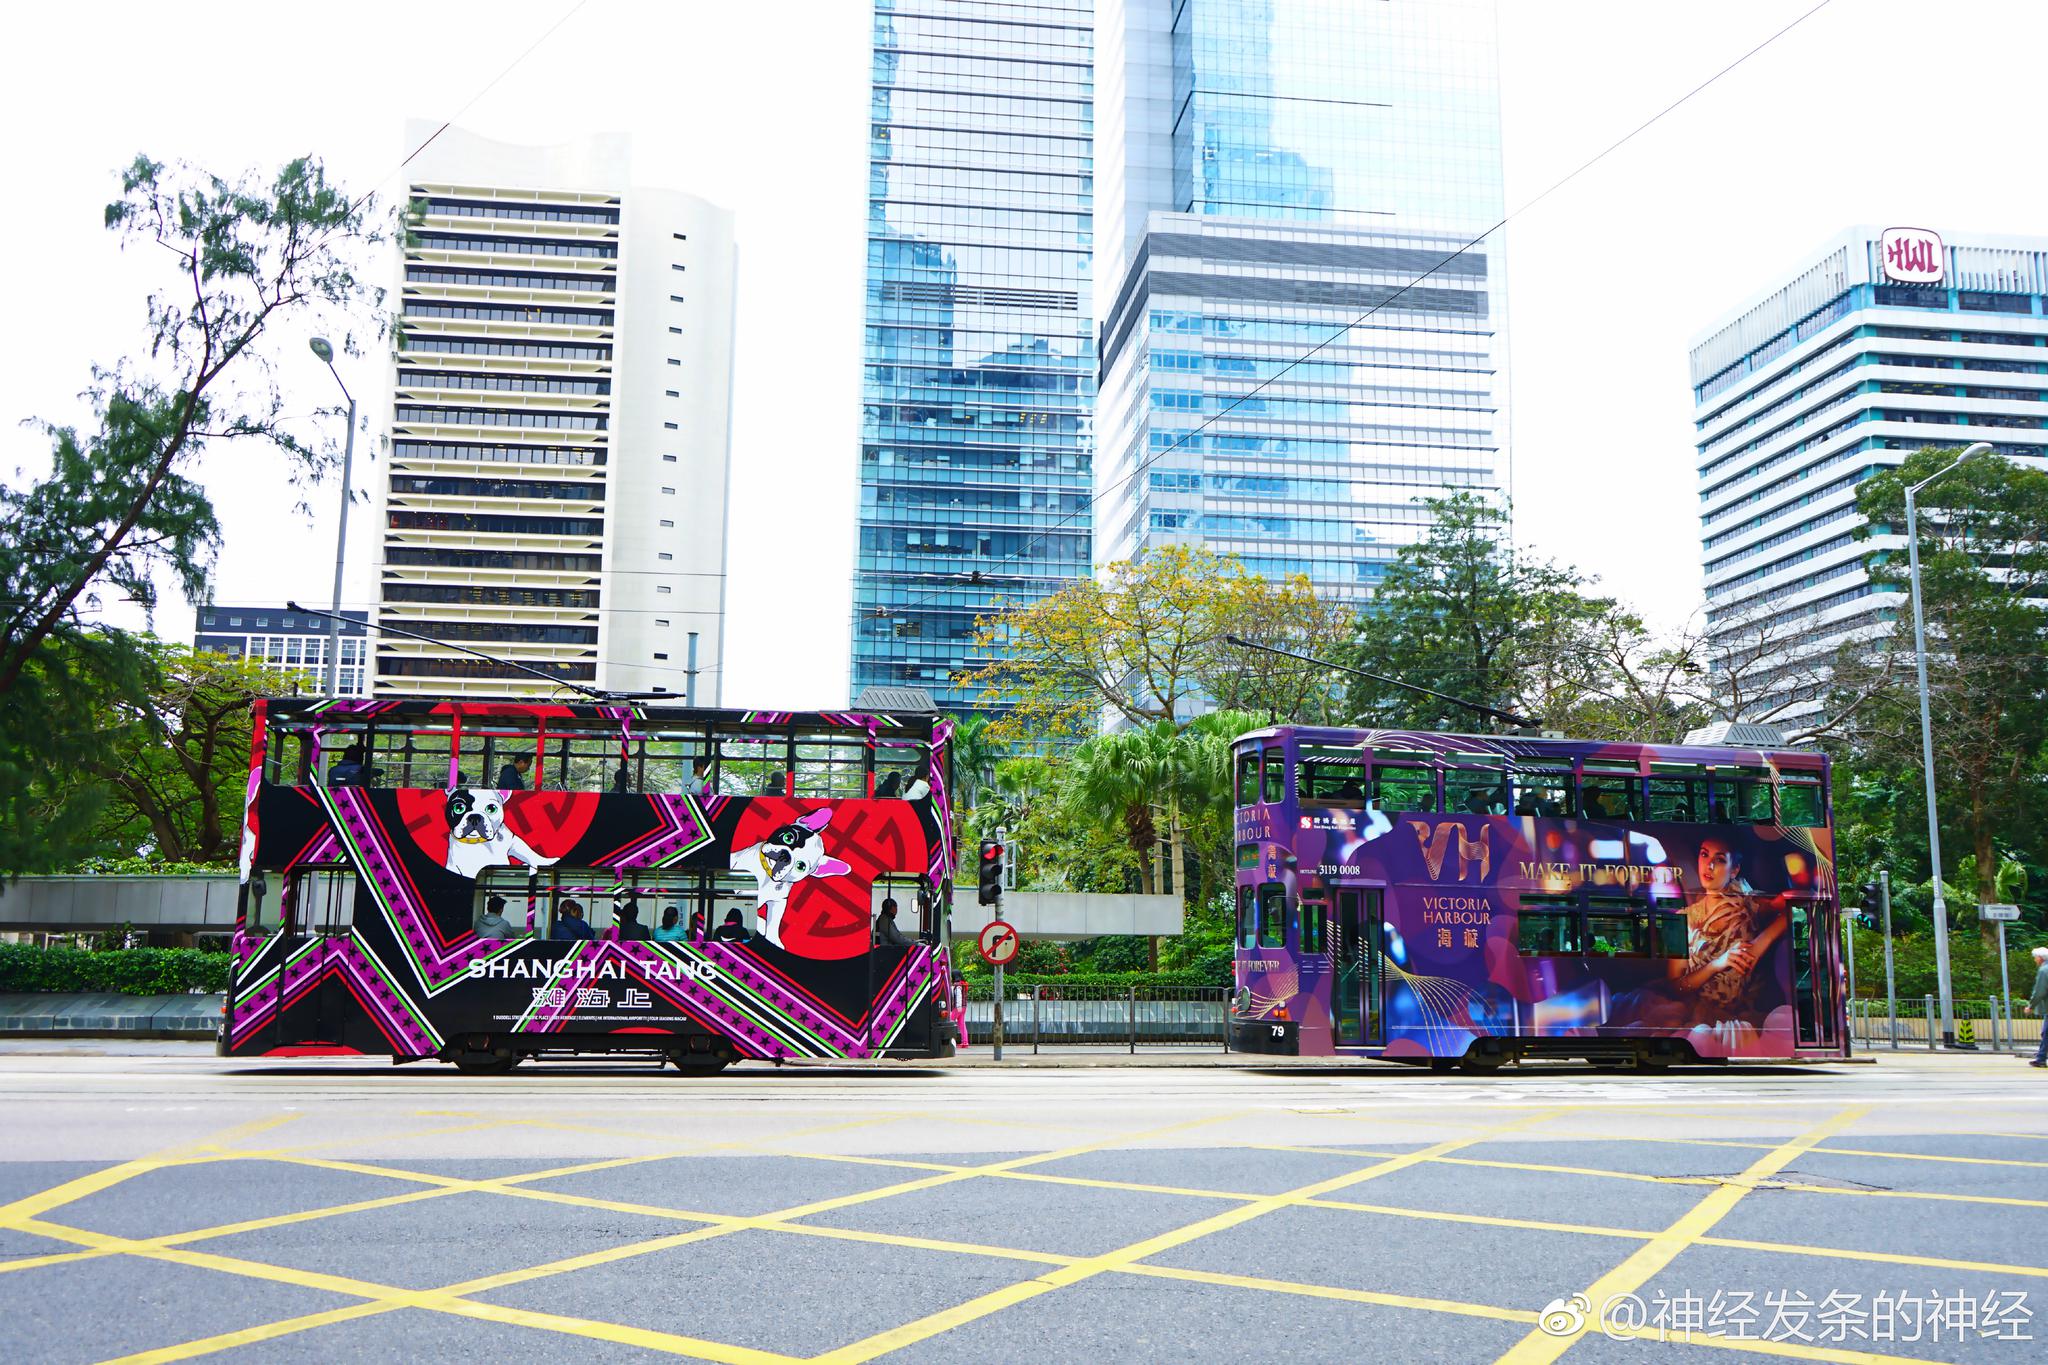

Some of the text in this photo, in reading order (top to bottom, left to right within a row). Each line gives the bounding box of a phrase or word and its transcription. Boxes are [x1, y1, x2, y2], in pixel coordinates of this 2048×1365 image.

[1887, 237, 1939, 274] HWL
[1319, 864, 1337, 875] 3119
[1339, 865, 1361, 875] 0008
[1519, 861, 1570, 881] MAKE
[1578, 862, 1596, 882] IT
[1423, 896, 1491, 911] VICTORIA
[1423, 911, 1492, 925] HARBOUR
[467, 957, 718, 981] SHANGHAI TANG
[1271, 1025, 1285, 1037] 79
